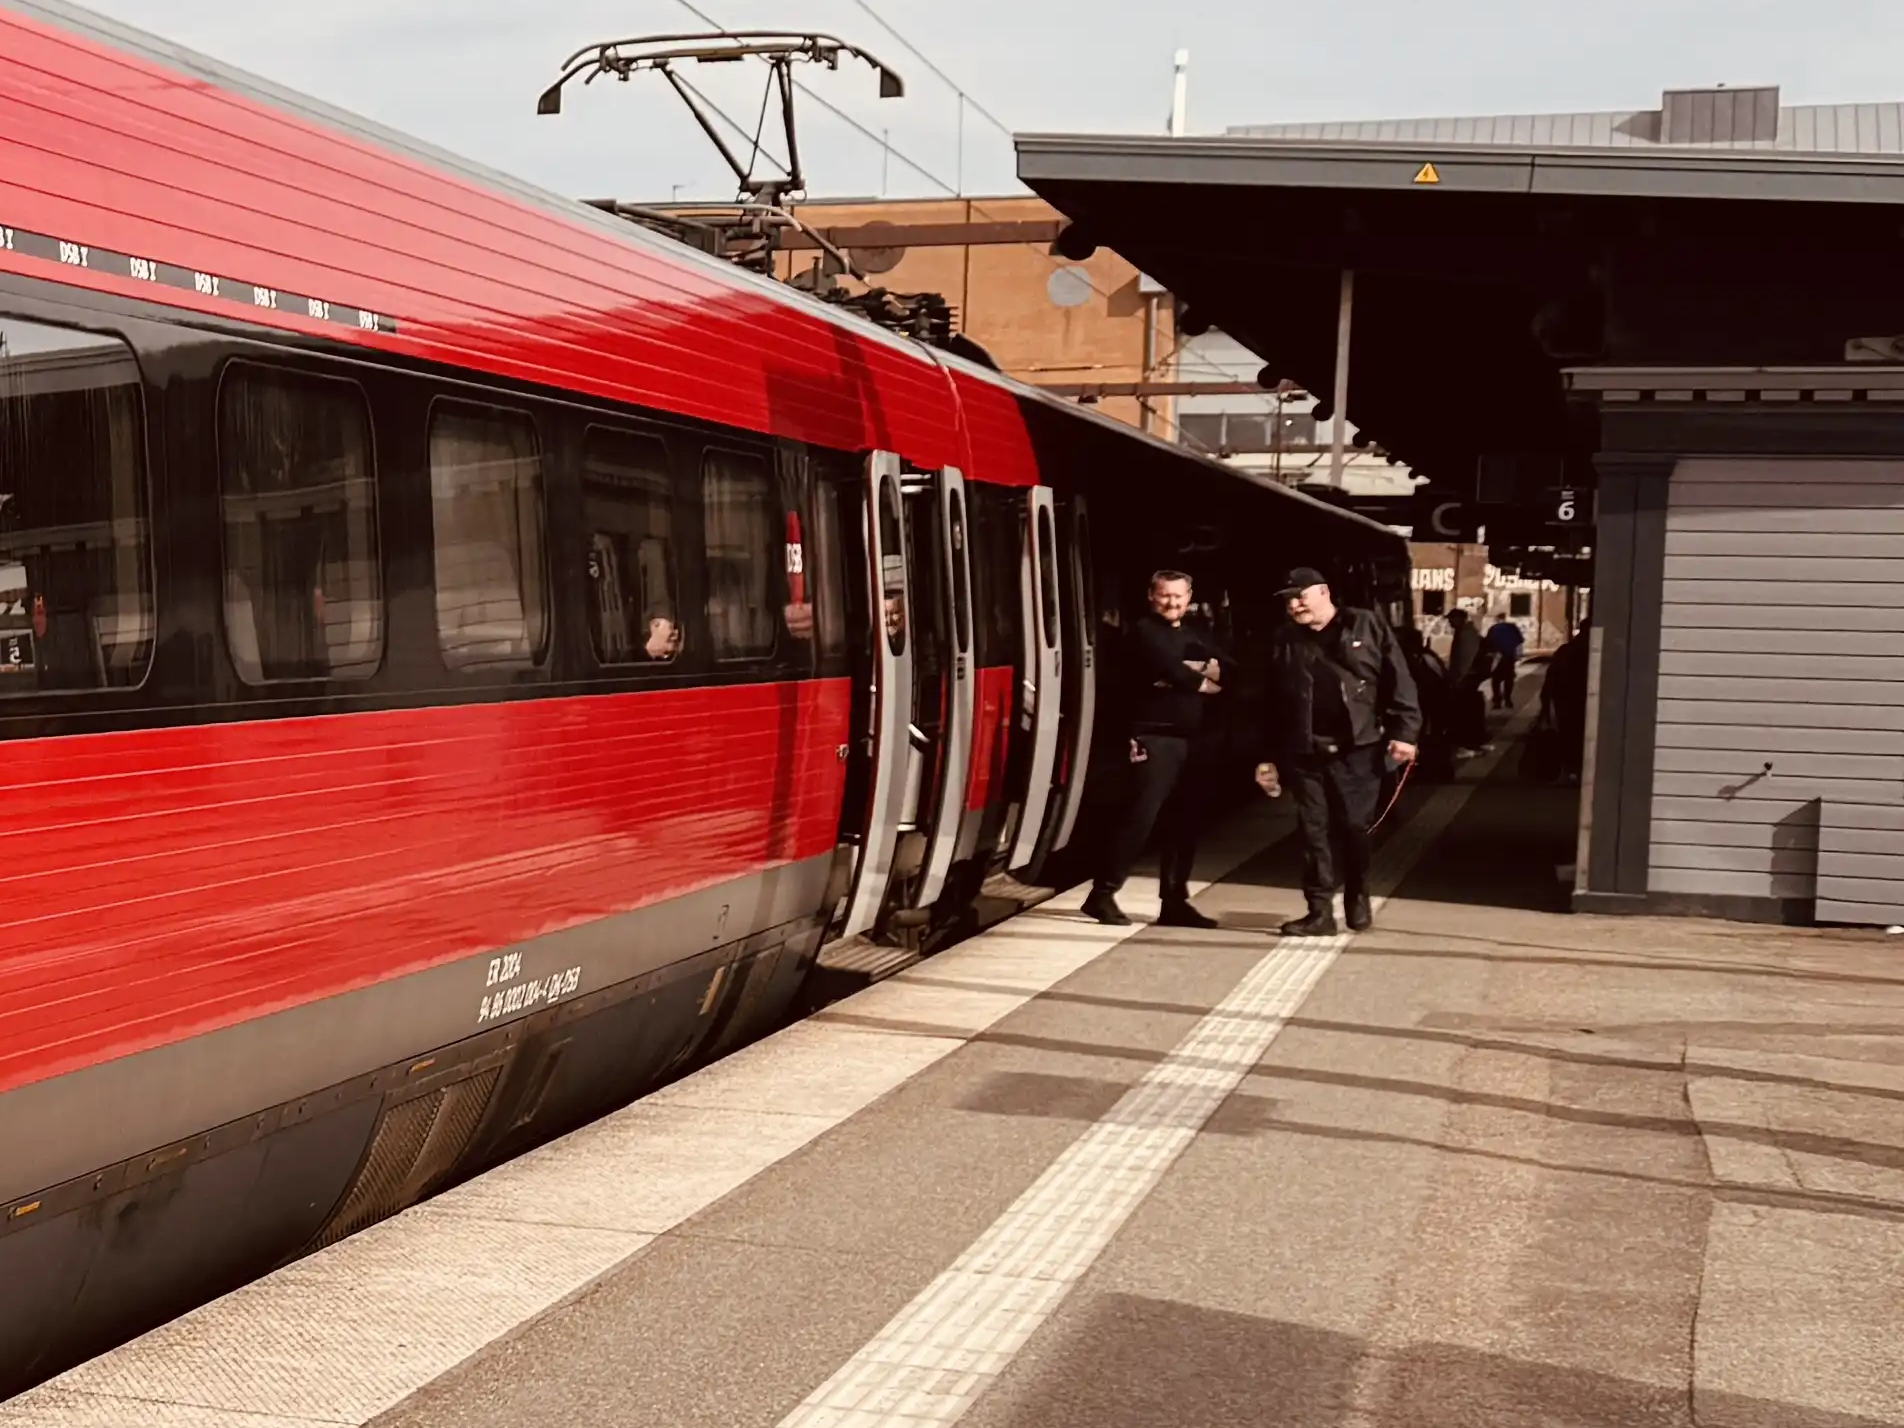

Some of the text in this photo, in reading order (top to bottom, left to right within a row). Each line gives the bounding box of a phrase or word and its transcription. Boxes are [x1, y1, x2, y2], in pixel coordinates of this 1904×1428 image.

[60, 241, 81, 265] DSB
[1558, 501, 1575, 521] 6
[786, 543, 803, 574] DSB
